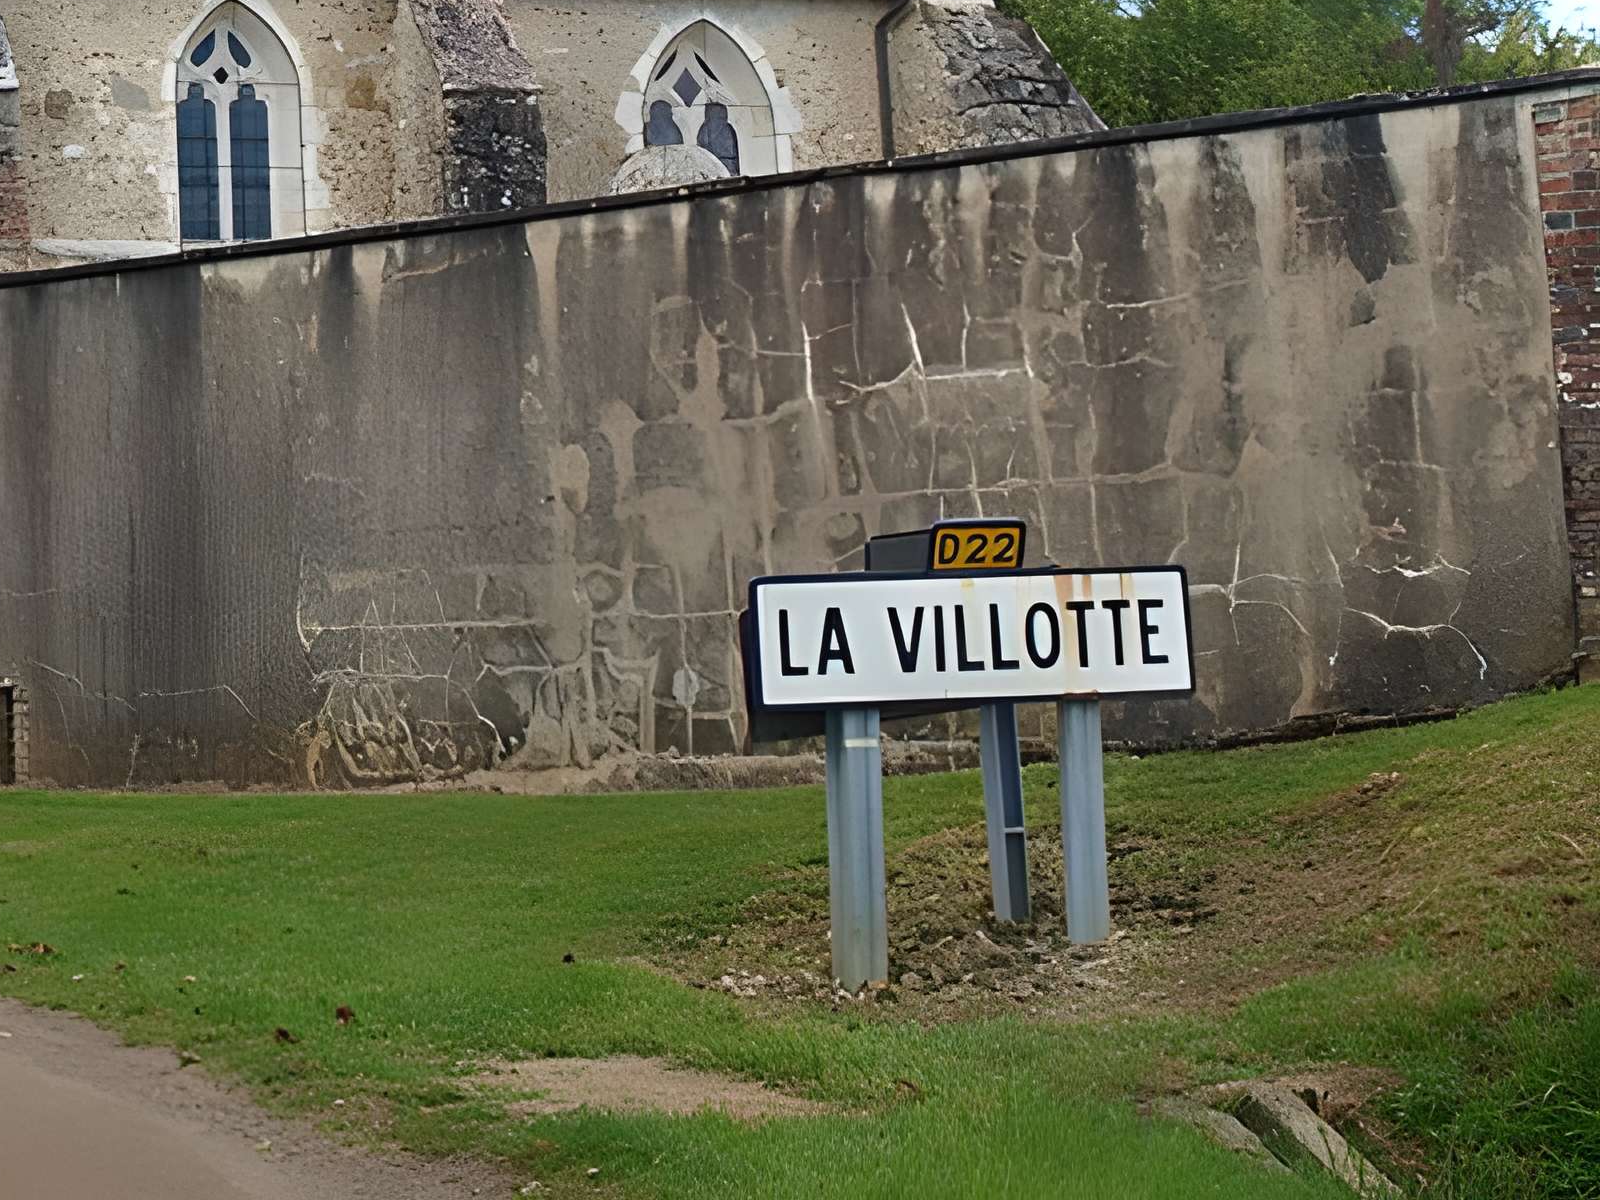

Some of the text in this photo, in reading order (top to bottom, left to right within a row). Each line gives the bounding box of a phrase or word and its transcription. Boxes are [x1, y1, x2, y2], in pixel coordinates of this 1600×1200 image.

[937, 532, 1015, 566] D22
[778, 598, 1169, 677] LA VILLOTTE
